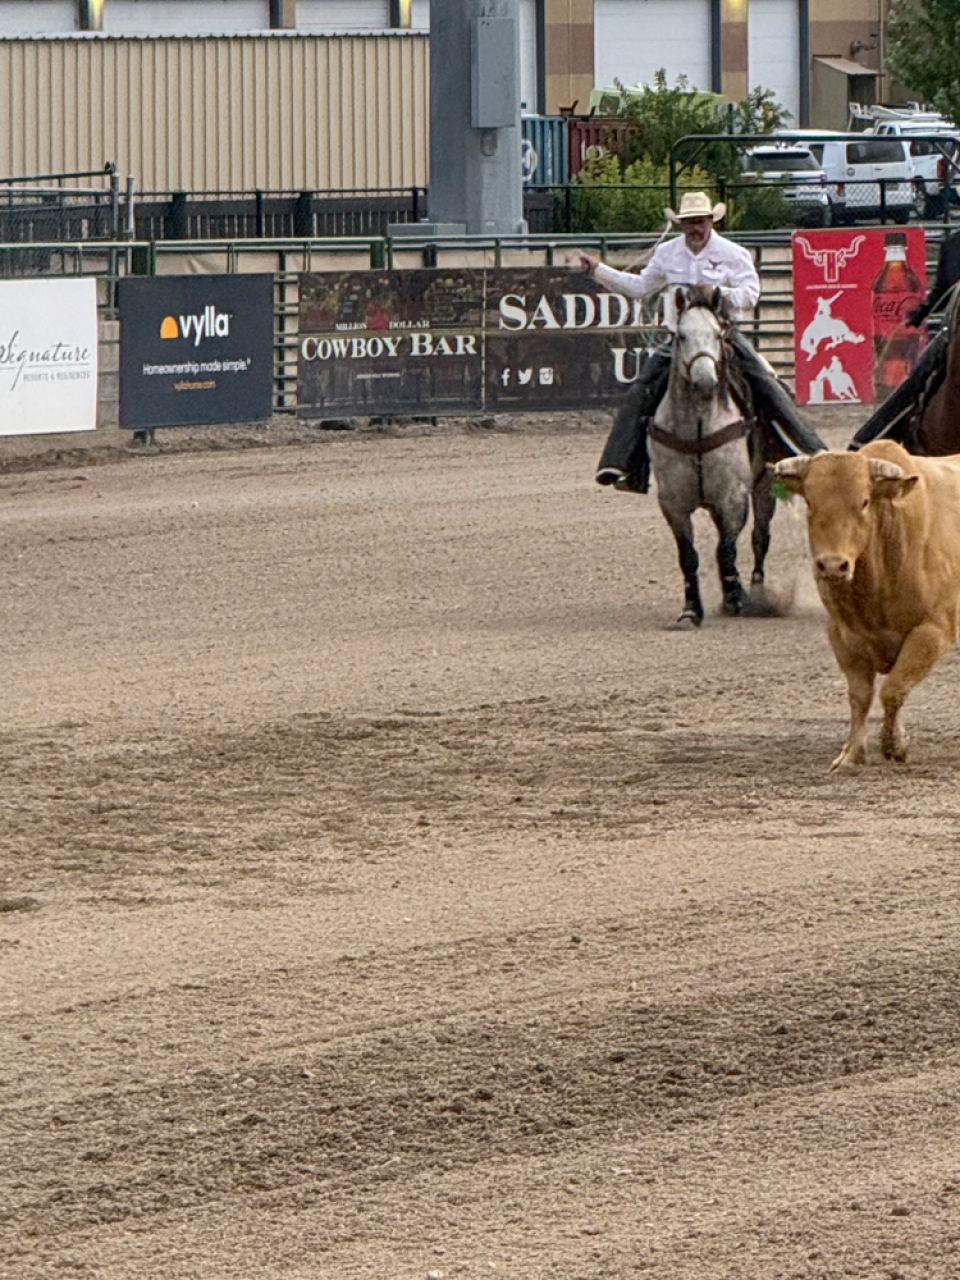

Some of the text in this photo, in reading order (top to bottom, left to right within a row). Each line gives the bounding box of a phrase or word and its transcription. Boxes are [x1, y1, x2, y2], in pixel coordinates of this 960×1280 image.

[179, 305, 229, 348] vylla
[336, 320, 430, 332] MILLION DOLLAR
[499, 293, 677, 331] SADDL
[301, 332, 478, 361] COWBOY BAR
